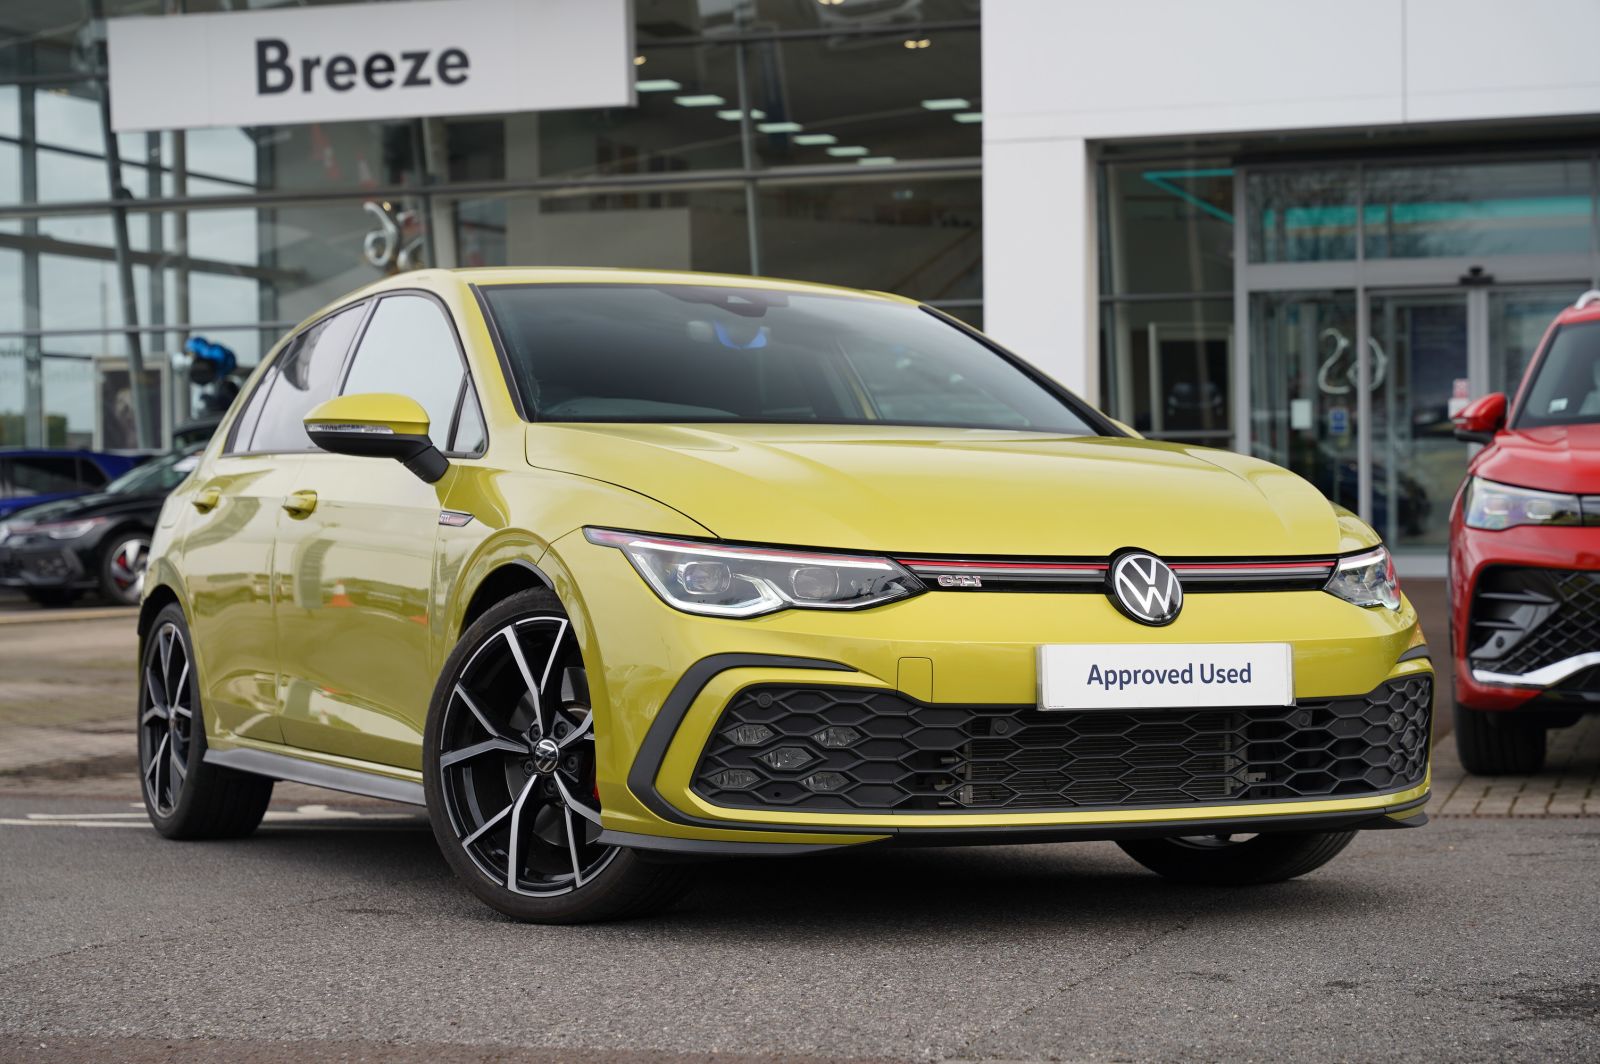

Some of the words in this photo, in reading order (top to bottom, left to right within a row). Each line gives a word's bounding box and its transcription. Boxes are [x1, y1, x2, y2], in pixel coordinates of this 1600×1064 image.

[255, 37, 470, 96] Breeze
[937, 574, 982, 588] GTI
[1115, 554, 1182, 620] VW
[1087, 662, 1194, 691] Approved
[1199, 662, 1252, 685] Used
